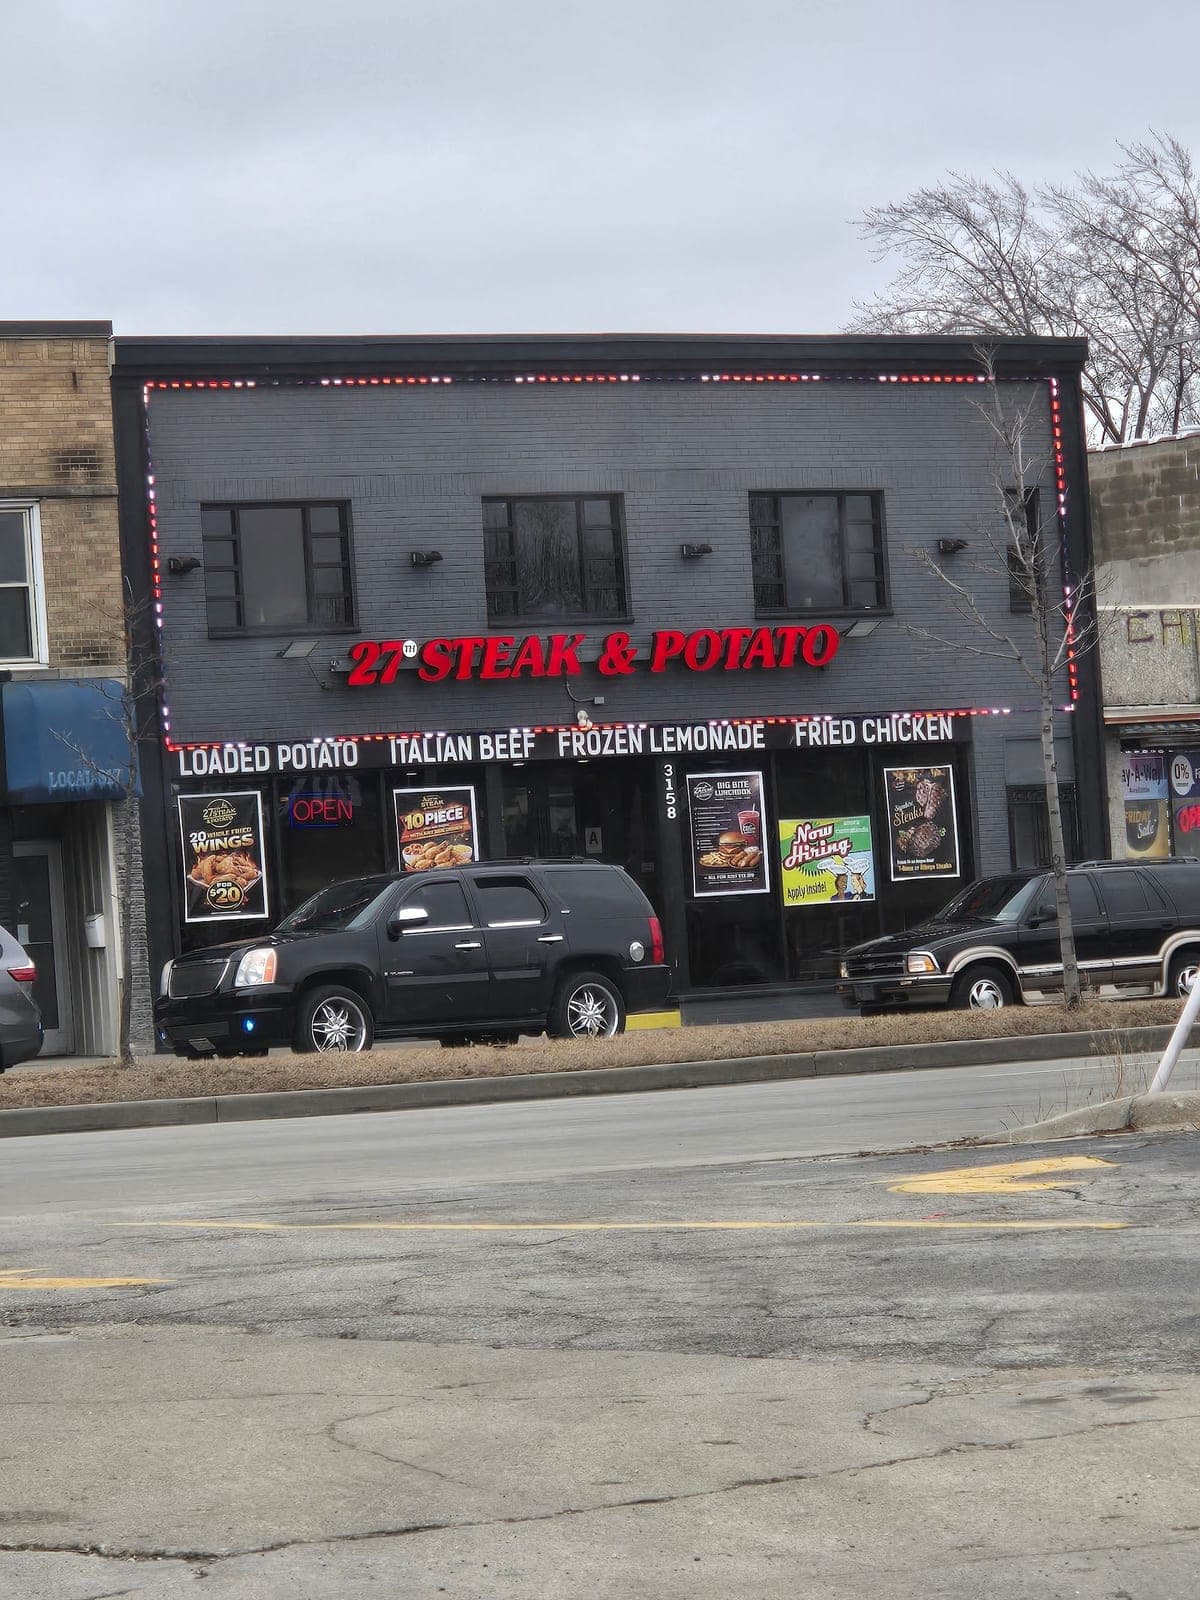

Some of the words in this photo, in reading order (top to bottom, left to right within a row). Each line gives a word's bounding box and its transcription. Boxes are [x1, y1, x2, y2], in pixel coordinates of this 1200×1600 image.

[348, 639, 404, 686] 27
[418, 633, 586, 682] STEAK
[598, 631, 638, 676] &
[651, 623, 840, 673] POTATO
[557, 727, 644, 757] FROZEN
[649, 723, 766, 754] LEMONADE
[795, 719, 857, 747] FRIED
[861, 715, 954, 743] CHICKEN
[178, 745, 271, 776] LOADED
[277, 740, 359, 770] POTATO
[389, 734, 473, 765] ITALIAN
[480, 733, 536, 760] BEEF
[48, 770, 93, 788] LOCAL
[1122, 763, 1161, 787] ay-A-Way
[1174, 763, 1190, 780] 0%
[663, 764, 677, 819] 3158
[717, 781, 731, 789] BIG
[732, 780, 750, 789] BITE
[202, 807, 214, 818] 27
[292, 798, 353, 821] OPEN
[405, 813, 424, 830] 10
[425, 807, 464, 825] PIECE
[893, 805, 924, 827] Steaks
[189, 831, 207, 844] 20
[191, 833, 255, 854] WINGS
[588, 831, 599, 845] A
[793, 823, 833, 845] Now
[784, 839, 851, 868] Hiring
[209, 886, 241, 904] $20
[787, 886, 806, 901] Apply
